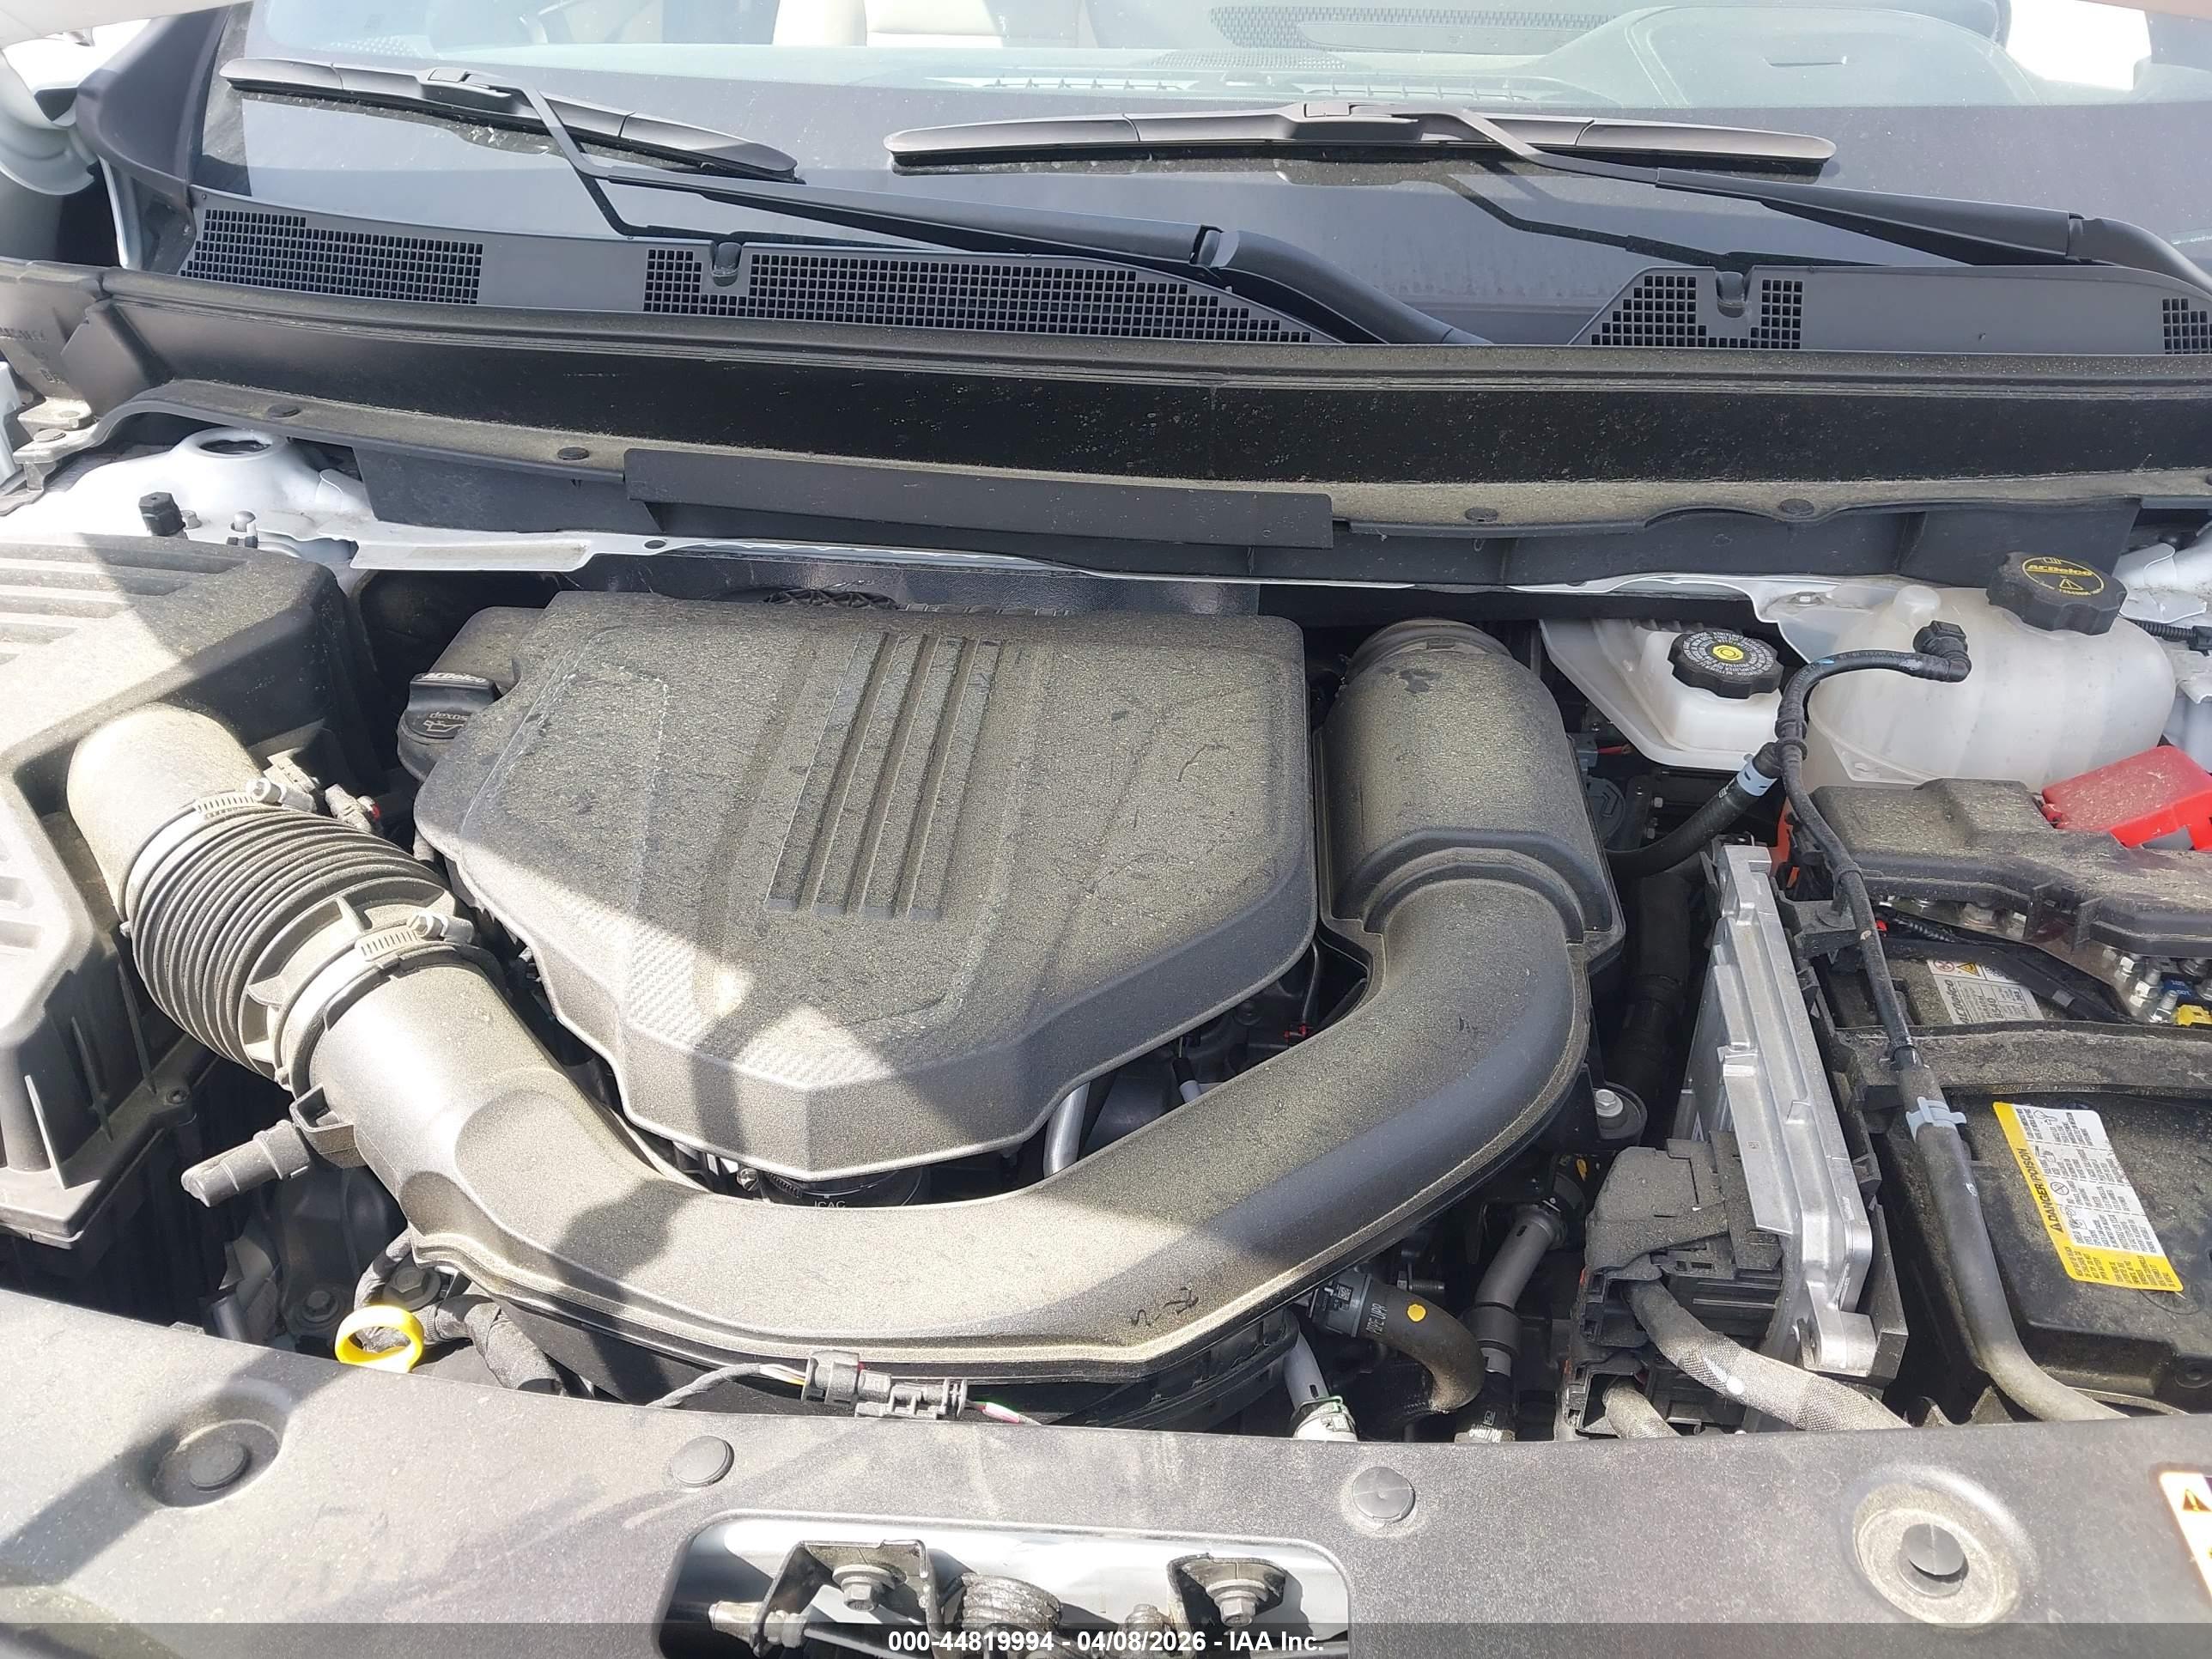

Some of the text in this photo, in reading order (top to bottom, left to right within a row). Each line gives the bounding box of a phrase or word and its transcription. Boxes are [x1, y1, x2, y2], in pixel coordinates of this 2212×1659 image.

[2027, 564, 2094, 576] ACDelco
[417, 672, 487, 684] ACDelco
[2017, 1148, 2059, 1224] DANGER/POISON
[1366, 1303, 1389, 1334] PIPE UPR
[1483, 1410, 1496, 1425] GM
